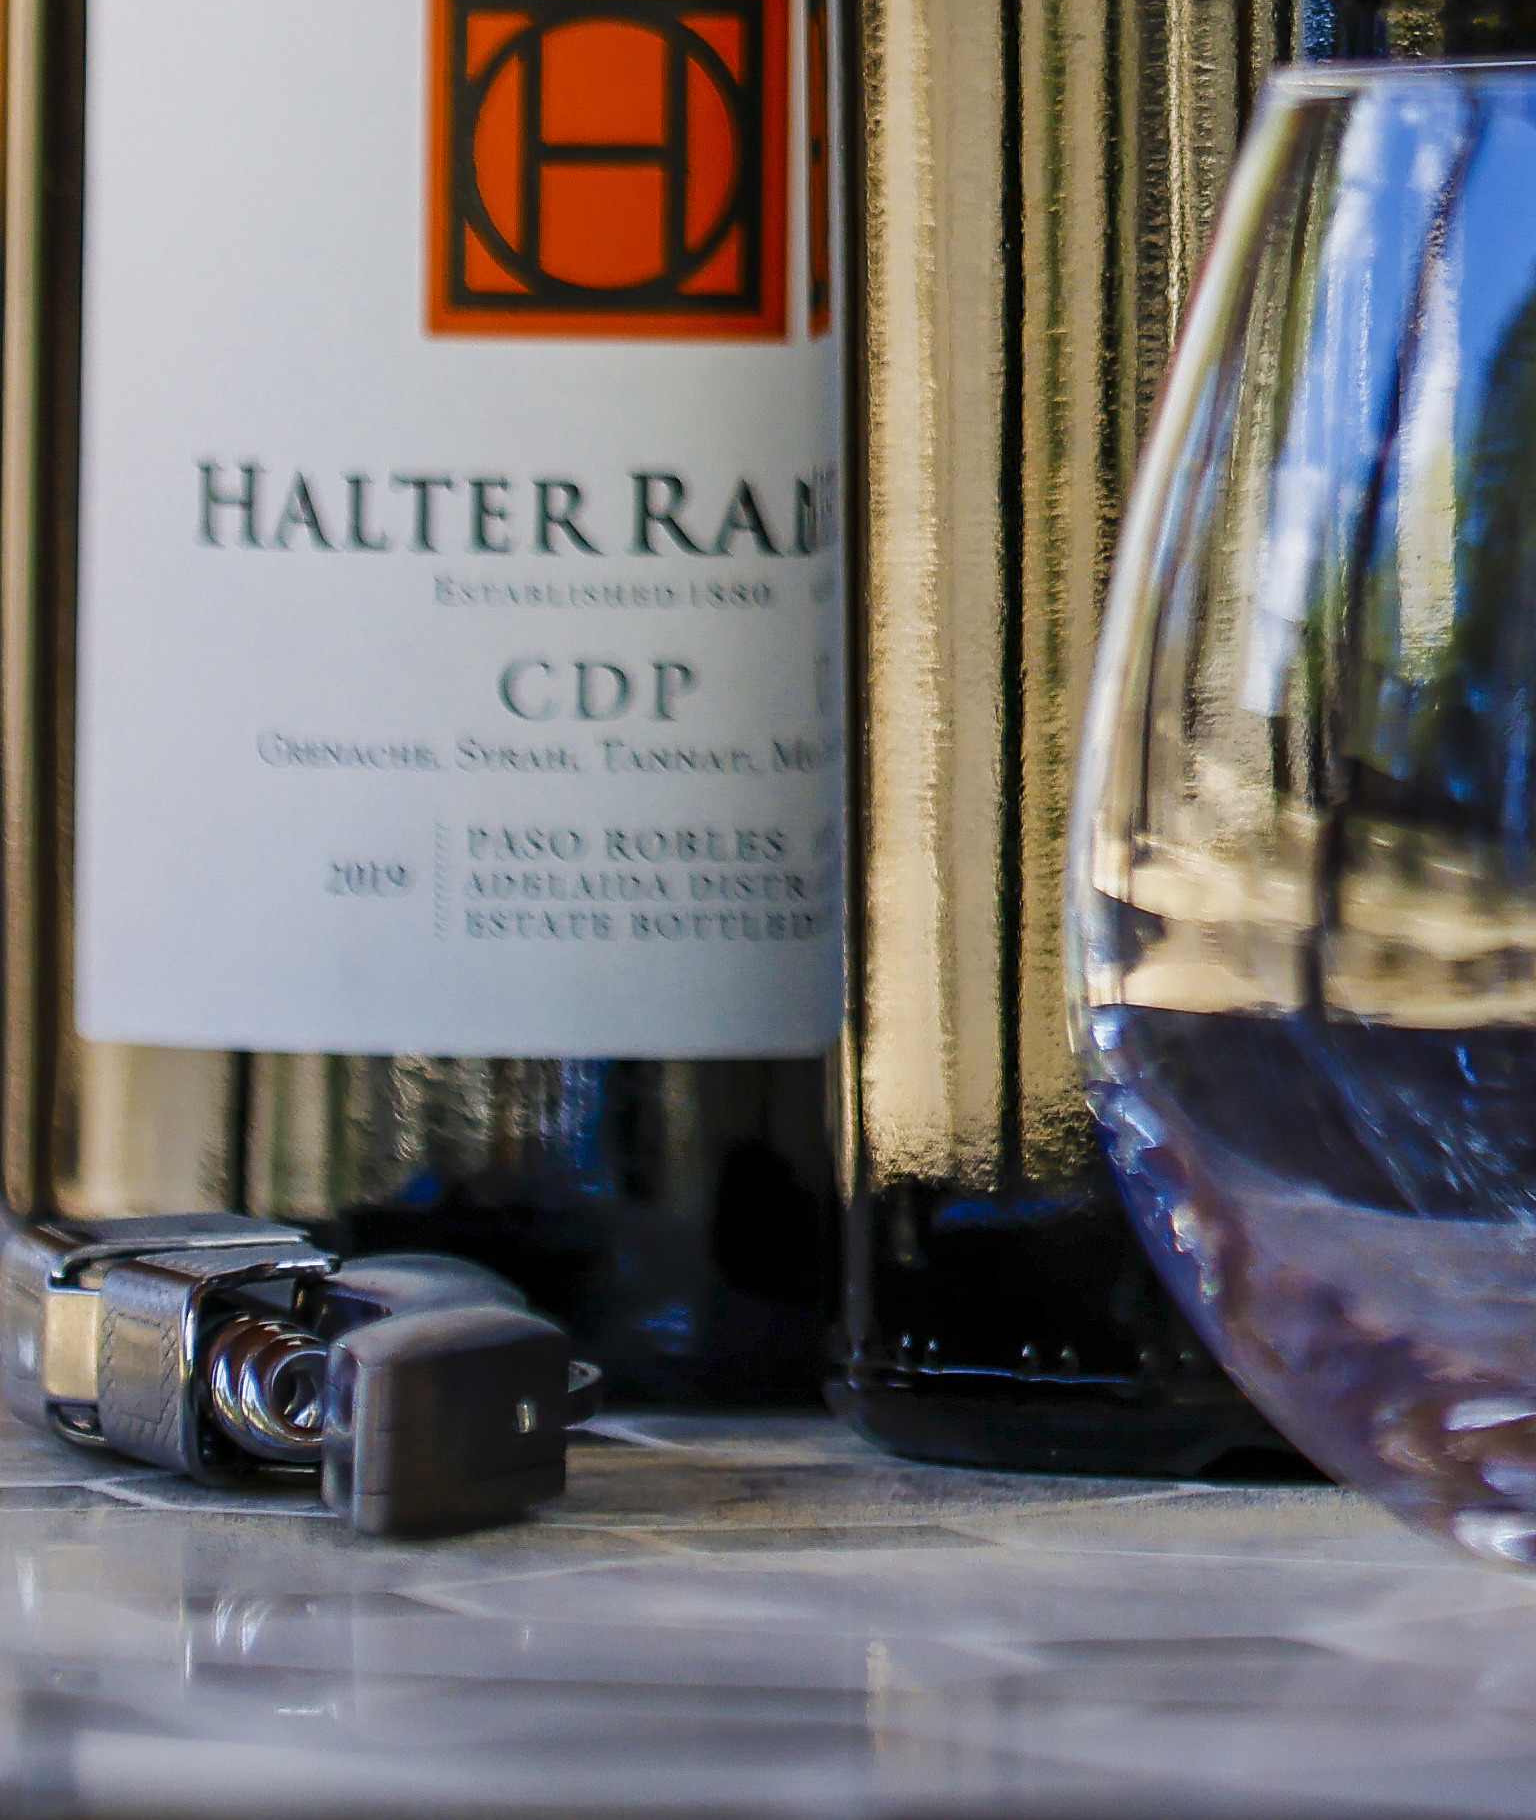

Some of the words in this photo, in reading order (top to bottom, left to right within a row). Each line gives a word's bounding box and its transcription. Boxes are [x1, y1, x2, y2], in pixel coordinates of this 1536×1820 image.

[194, 456, 603, 557] HALTER
[498, 658, 698, 722] CDP
[466, 826, 586, 861] PASO
[604, 827, 787, 862] ROBLES
[467, 871, 670, 901] ADELAIDA
[464, 909, 613, 941] ESTATE
